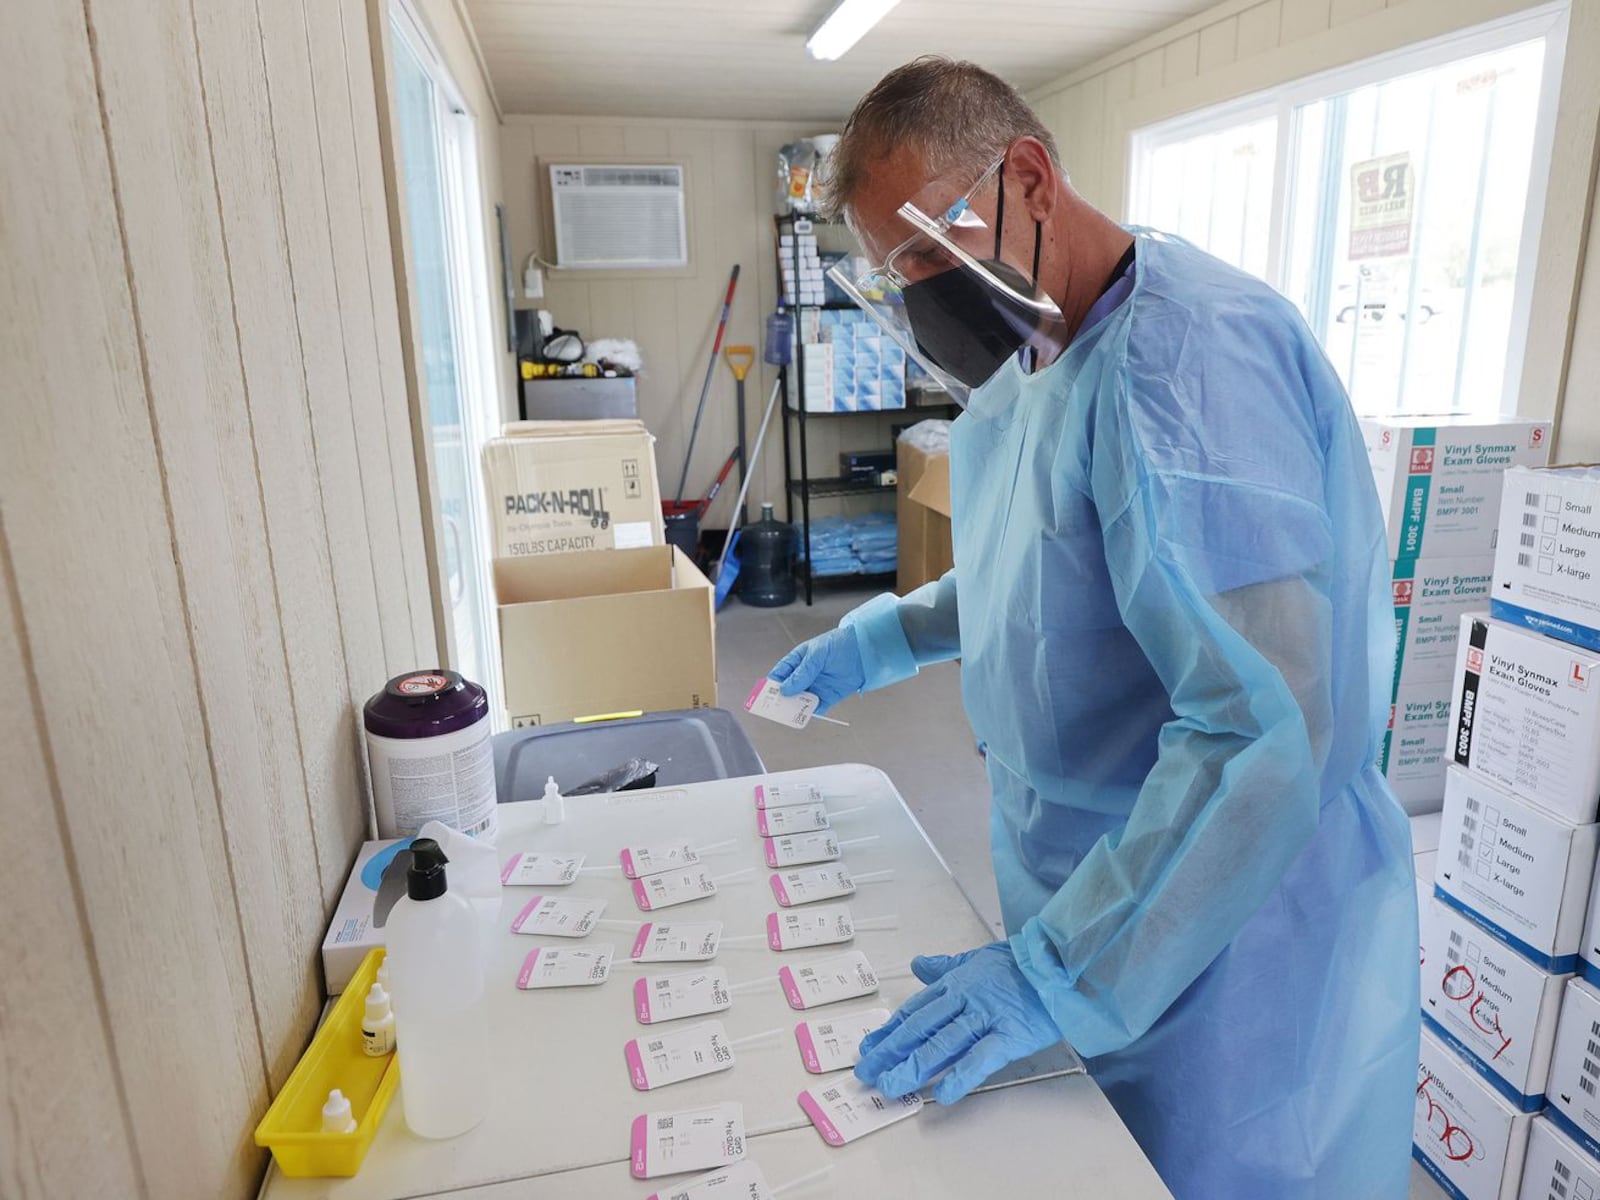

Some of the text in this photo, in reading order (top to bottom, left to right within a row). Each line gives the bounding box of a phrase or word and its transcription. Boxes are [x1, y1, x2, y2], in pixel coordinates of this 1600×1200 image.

[1532, 428, 1542, 441] S
[1445, 444, 1516, 456] Vinyl Synmax
[1443, 454, 1511, 465] Exam Gloves
[1440, 486, 1464, 494] Small
[505, 488, 610, 522] PACK-N-ROLL
[1565, 501, 1592, 515] Small
[1405, 488, 1424, 551] BMPF 3001
[508, 536, 595, 556] 150LBS CAPACITY
[1559, 543, 1586, 558] Large
[1557, 564, 1591, 580] X-large
[1423, 575, 1492, 588] Vinyl Synmax
[1422, 586, 1486, 597] Exam Gloves
[1418, 615, 1442, 624] Small
[1491, 654, 1516, 671] Vinyl
[1517, 665, 1558, 688] Synmax
[1573, 664, 1584, 682] L
[1489, 666, 1515, 683] Exam
[1517, 677, 1551, 696] Gloves
[1406, 702, 1432, 712] Vinyl
[1404, 713, 1433, 721] Exam
[1458, 690, 1475, 757] BMPF 3003
[1401, 738, 1425, 747] Small
[1502, 818, 1528, 837] Small
[1499, 837, 1535, 863] Medium
[1496, 855, 1521, 875] Large
[1493, 873, 1525, 897] X-large
[1483, 956, 1506, 977] Small
[1480, 974, 1513, 1003] Medium
